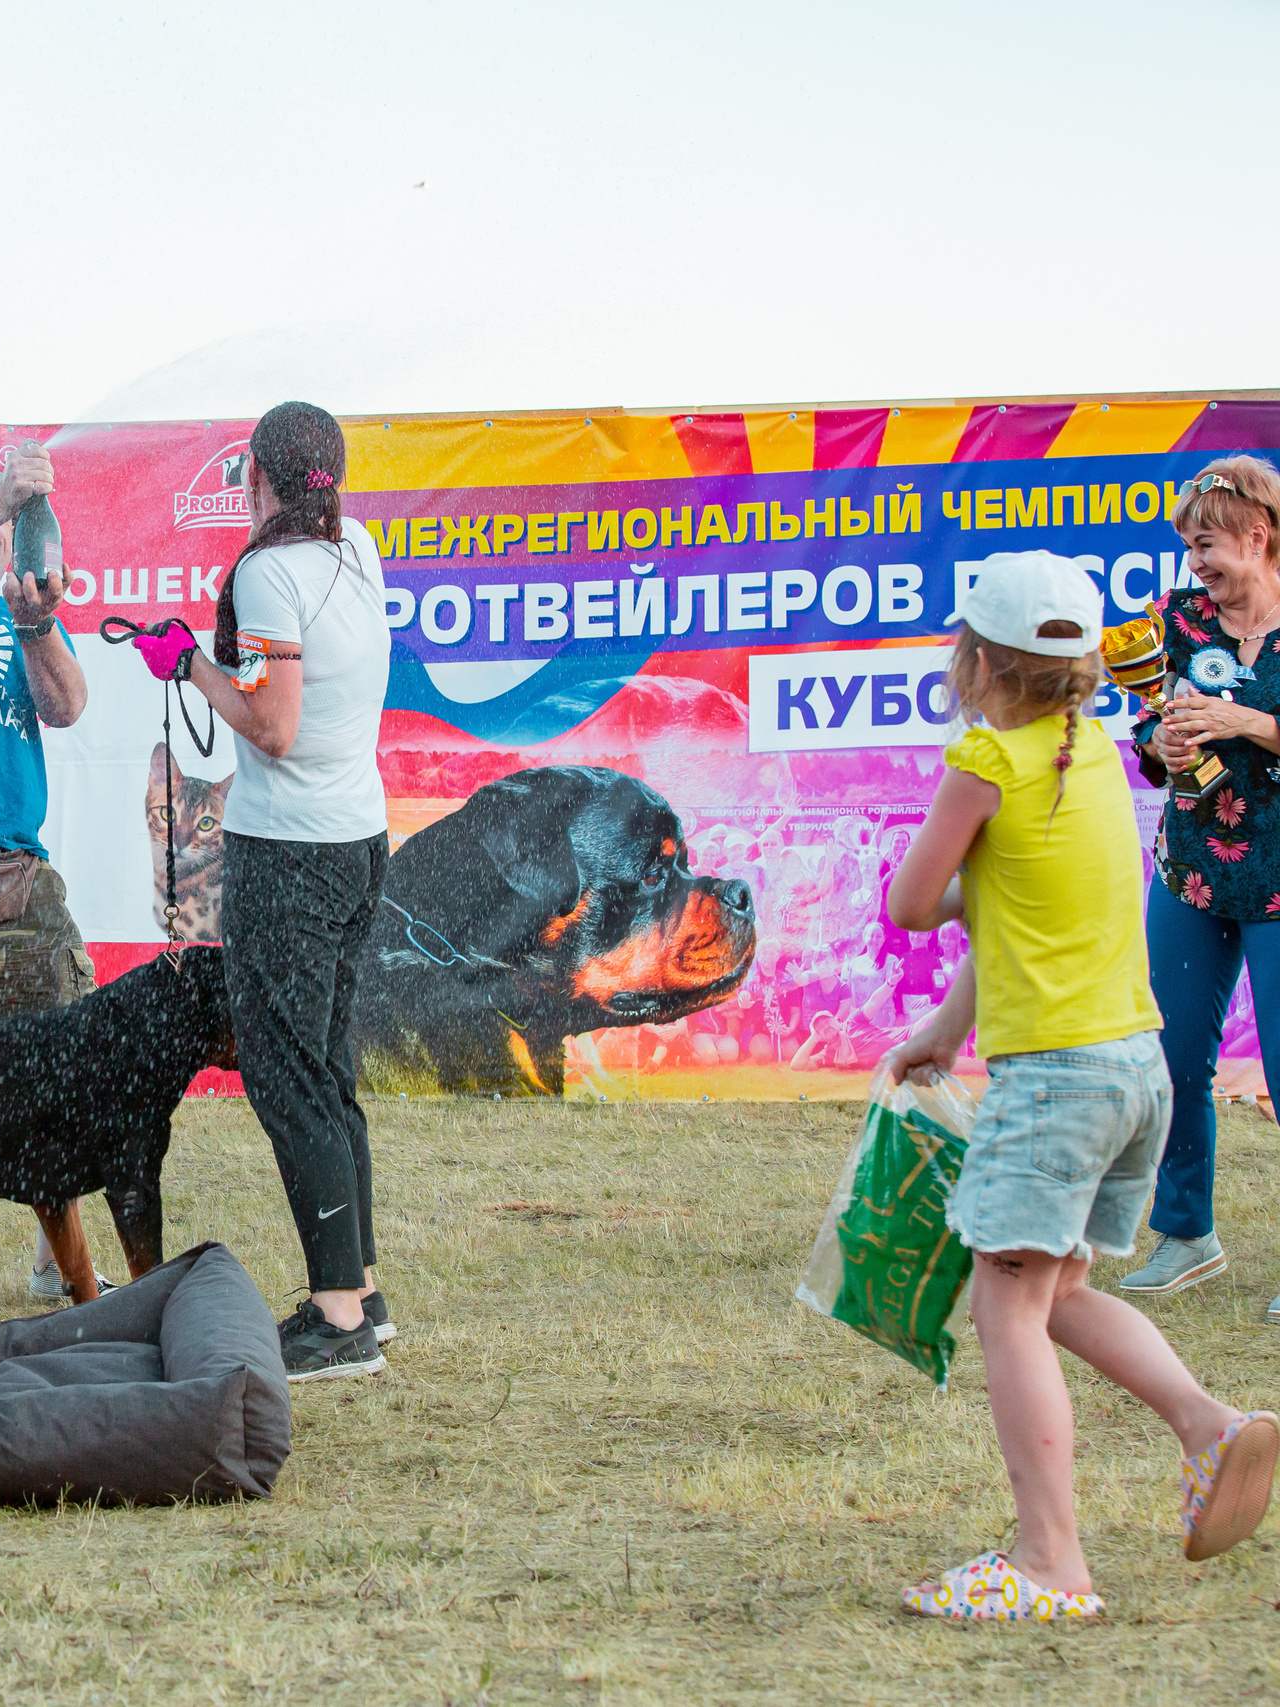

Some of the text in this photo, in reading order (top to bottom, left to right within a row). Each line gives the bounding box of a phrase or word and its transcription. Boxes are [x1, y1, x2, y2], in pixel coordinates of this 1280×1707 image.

[366, 480, 1181, 559] МЕЖРЕГИОНАЛЬНЫЙ ЧЕМПИОН
[63, 566, 223, 606] ОШЕК
[384, 563, 923, 645] РОТВЕЙЛЕРОВ
[777, 669, 960, 731] КУБО
